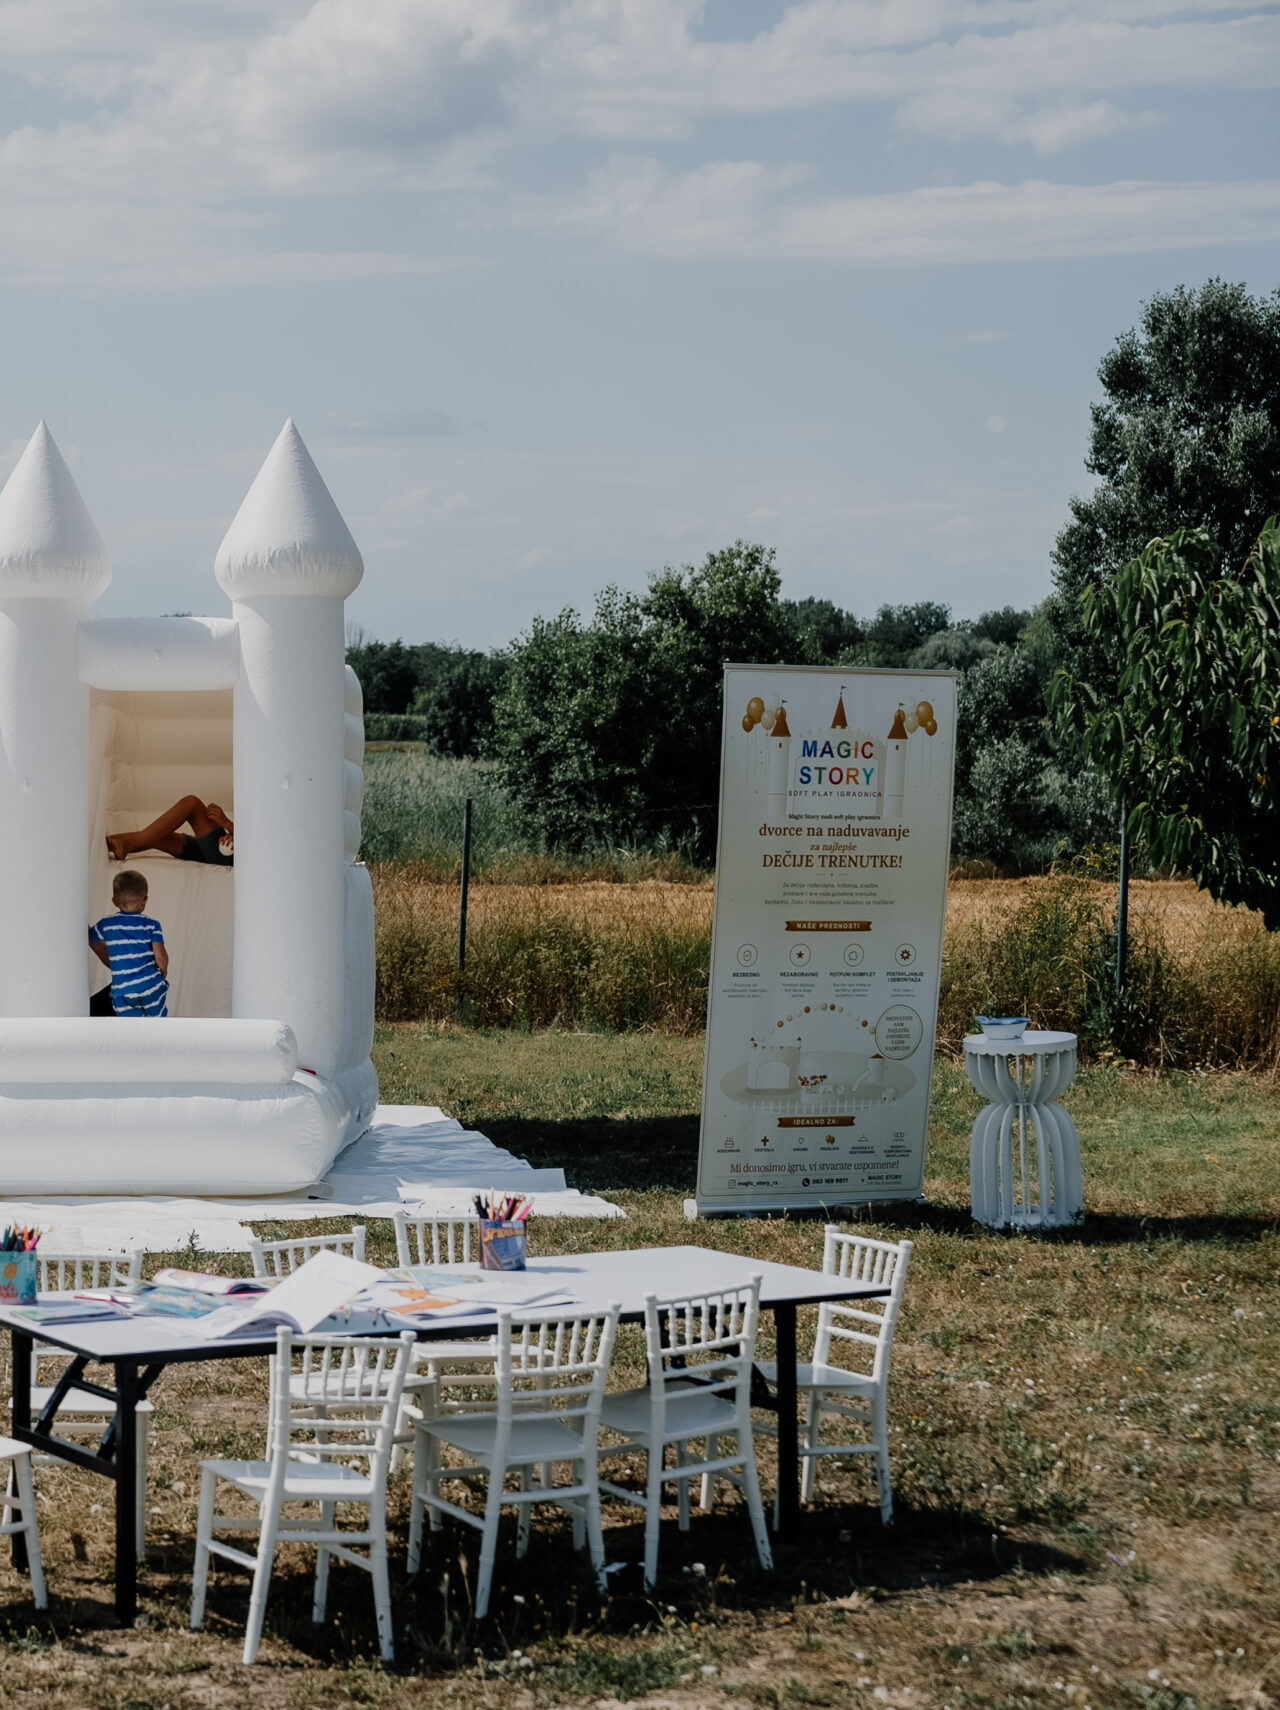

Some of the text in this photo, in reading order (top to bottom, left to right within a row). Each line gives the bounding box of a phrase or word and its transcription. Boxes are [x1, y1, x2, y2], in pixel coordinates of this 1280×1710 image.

[802, 740, 874, 760] MAGIC
[799, 766, 875, 785] STORY
[837, 790, 882, 798] IGRAONICA
[759, 823, 910, 841] dvorce na naduvavanje
[810, 841, 857, 854] za najlepše
[762, 850, 903, 868] DEČIJE TRENUTKE!
[730, 1160, 899, 1174] Mi donosimo igru, vi stvarate uspomene!
